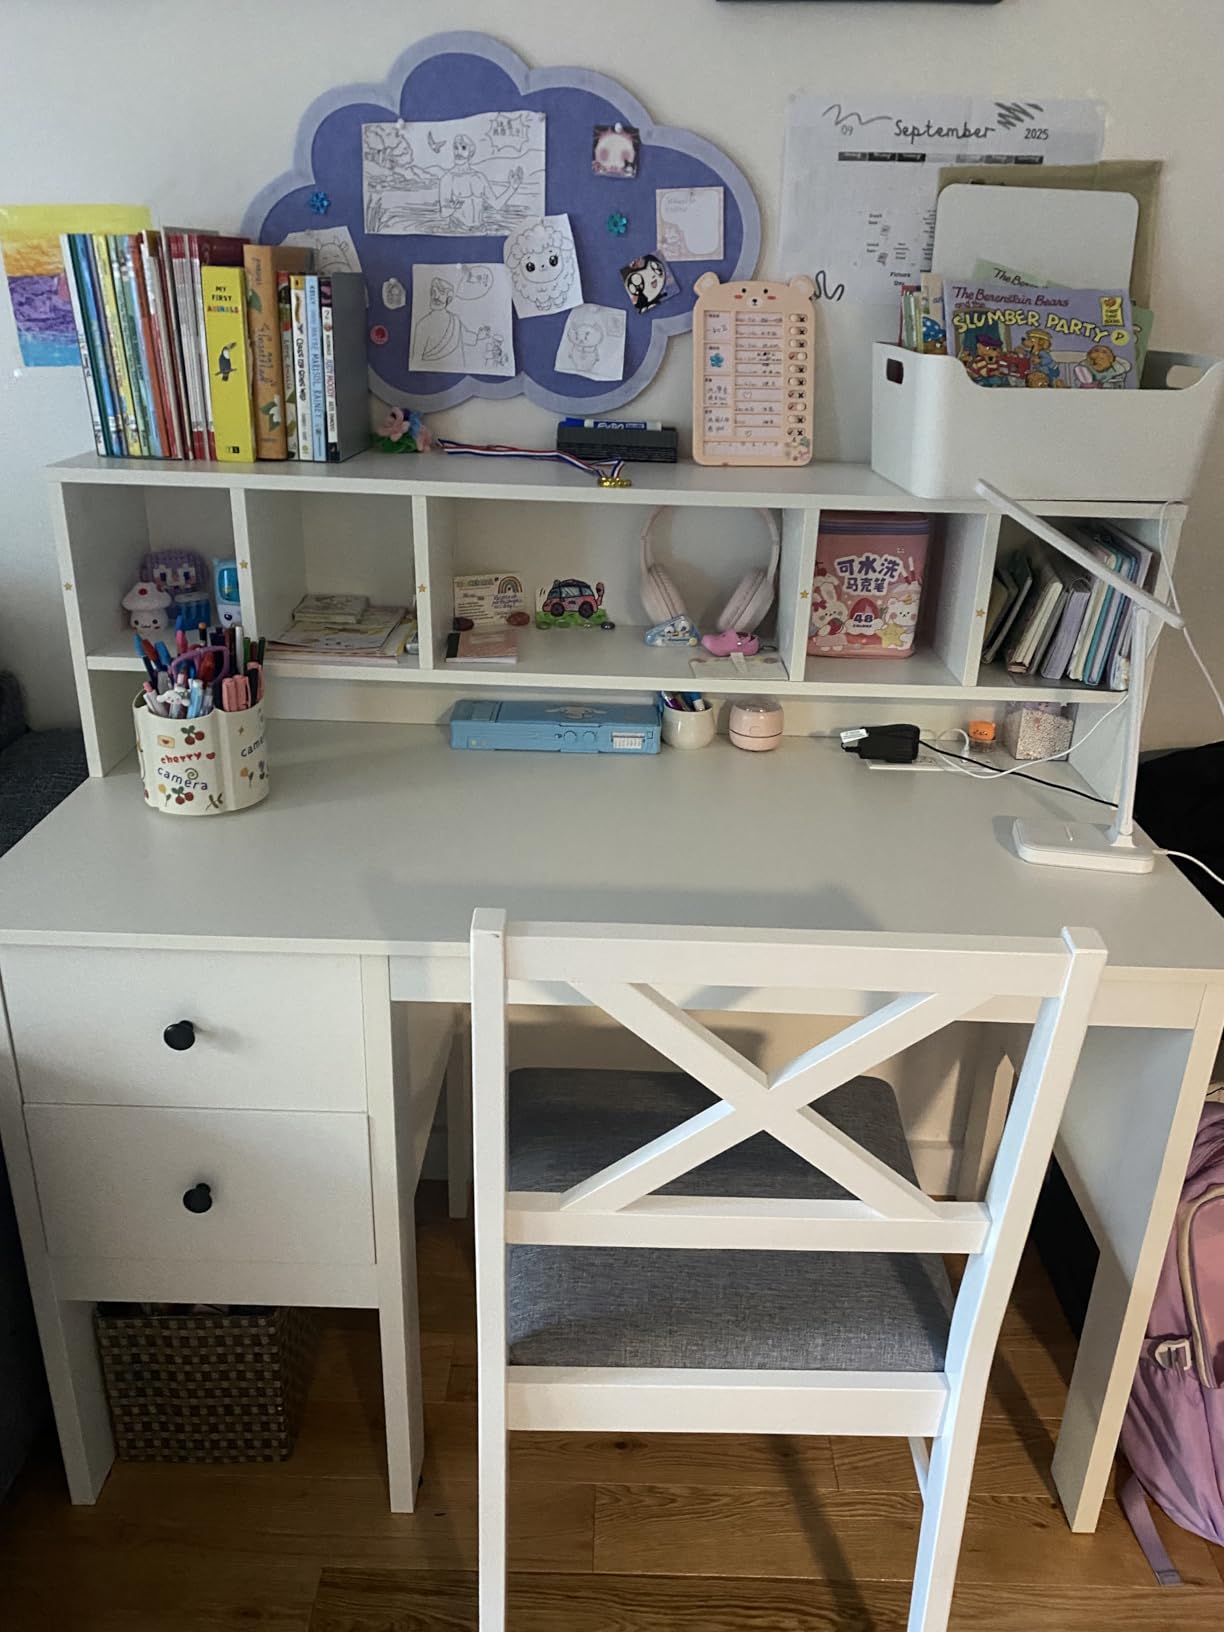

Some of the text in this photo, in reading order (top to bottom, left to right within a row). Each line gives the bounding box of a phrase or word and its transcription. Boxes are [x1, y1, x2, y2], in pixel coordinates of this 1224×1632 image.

[894, 119, 996, 144] September
[1023, 127, 1049, 141] 2025
[993, 267, 1012, 283] The
[211, 294, 233, 302] FIRST
[952, 286, 975, 300] The
[1034, 294, 1069, 307] Bears
[952, 309, 1109, 343] SLUMBER PARTY
[836, 555, 900, 579] 可水洗
[845, 577, 887, 593] 马克笔
[853, 613, 874, 624] 48
[160, 751, 202, 764] cherry
[157, 766, 208, 791] camera
